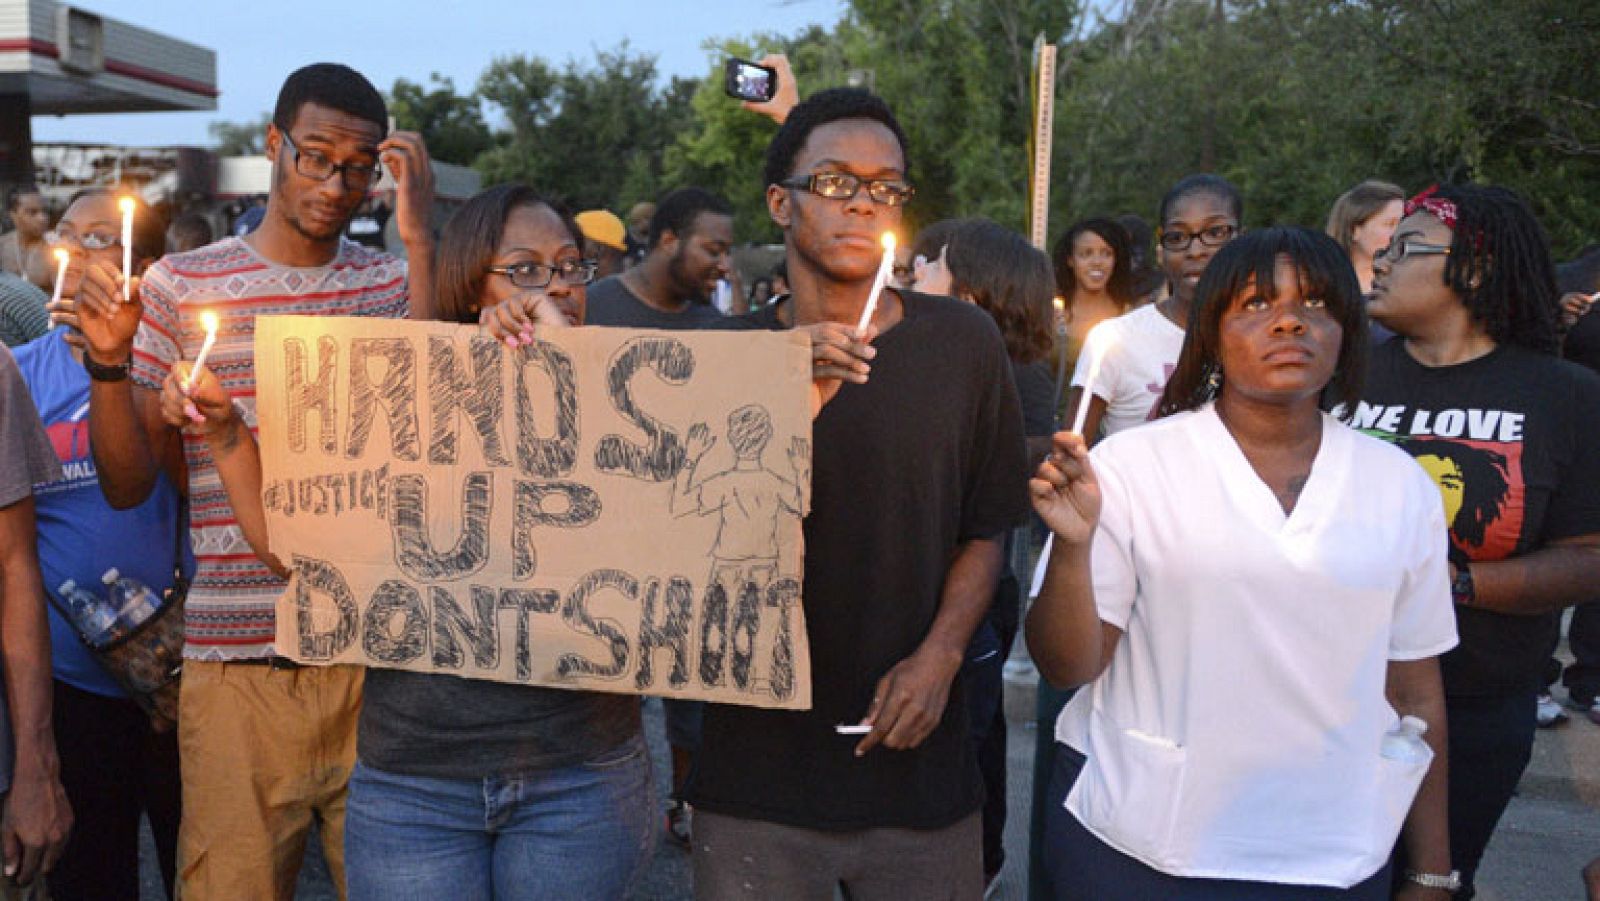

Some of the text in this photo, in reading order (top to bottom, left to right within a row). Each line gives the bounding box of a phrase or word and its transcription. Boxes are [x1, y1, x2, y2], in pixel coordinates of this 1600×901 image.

[283, 335, 696, 482] HANDS
[1409, 408, 1526, 442] LOVE
[387, 471, 602, 582] UP
[291, 554, 801, 701] DONT SHOOT
